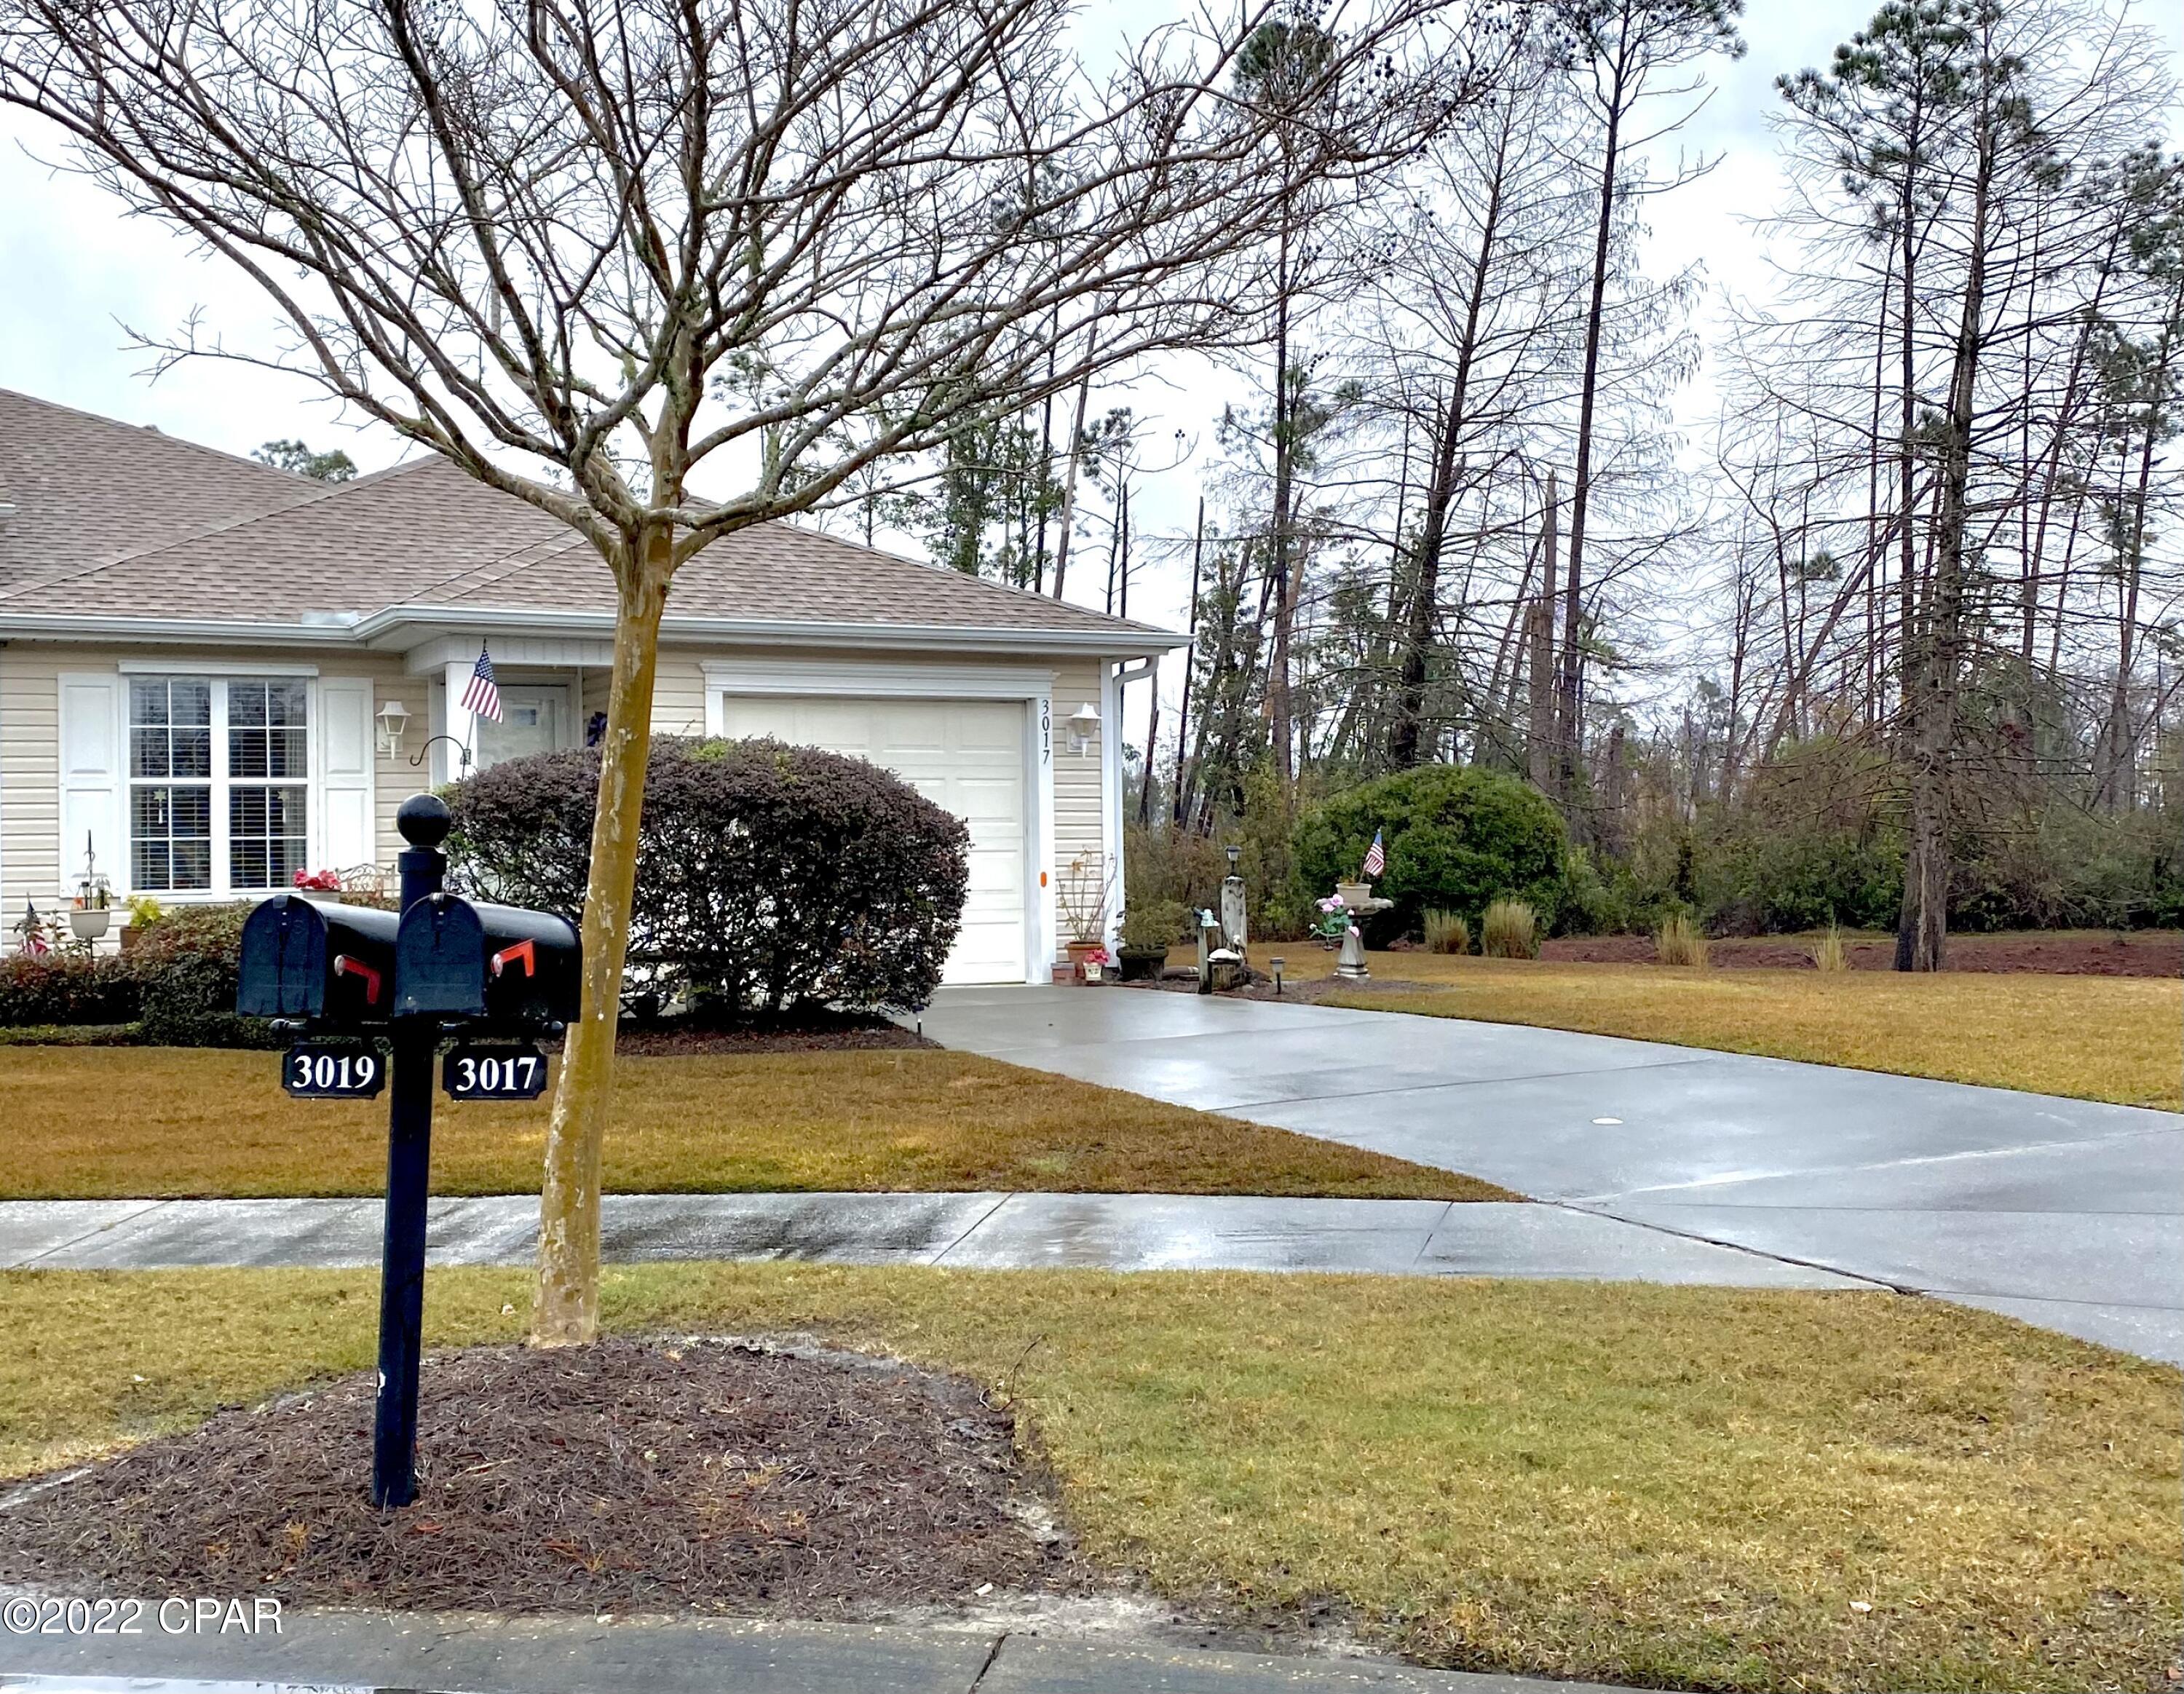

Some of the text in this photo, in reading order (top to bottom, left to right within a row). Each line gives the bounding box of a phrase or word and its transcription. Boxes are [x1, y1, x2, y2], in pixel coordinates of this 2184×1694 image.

[1042, 699, 1050, 764] 3017
[292, 1055, 375, 1089] 3019
[456, 1056, 537, 1091] 3017
